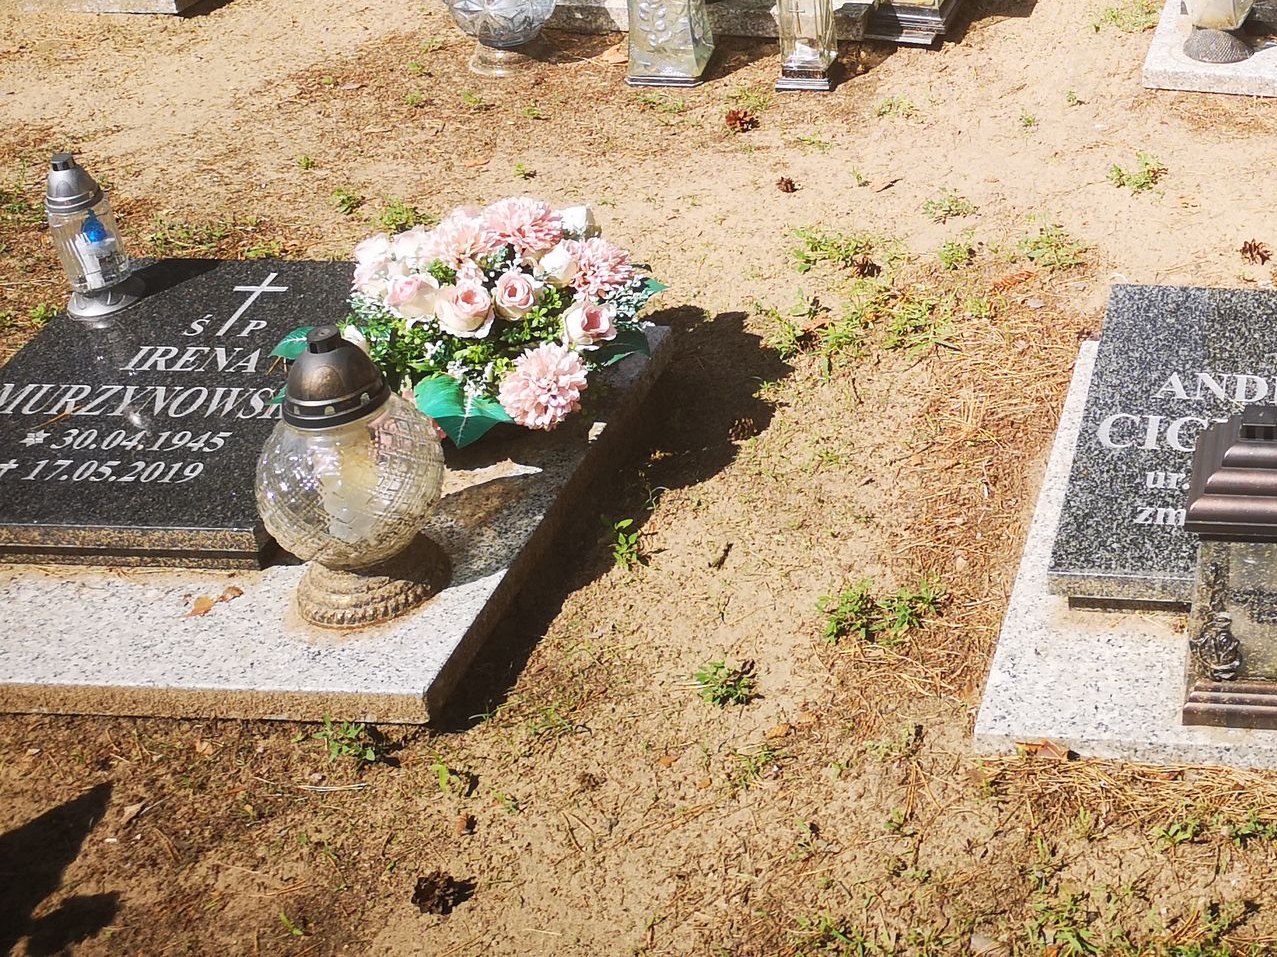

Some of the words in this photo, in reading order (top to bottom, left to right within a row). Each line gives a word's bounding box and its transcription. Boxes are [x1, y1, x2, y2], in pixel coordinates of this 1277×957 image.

[236, 319, 268, 338] P
[119, 345, 262, 373] IRENA
[50, 428, 234, 453] 30.04.1945
[21, 459, 205, 484] 17.05.2019
[1146, 471, 1191, 491] ur.
